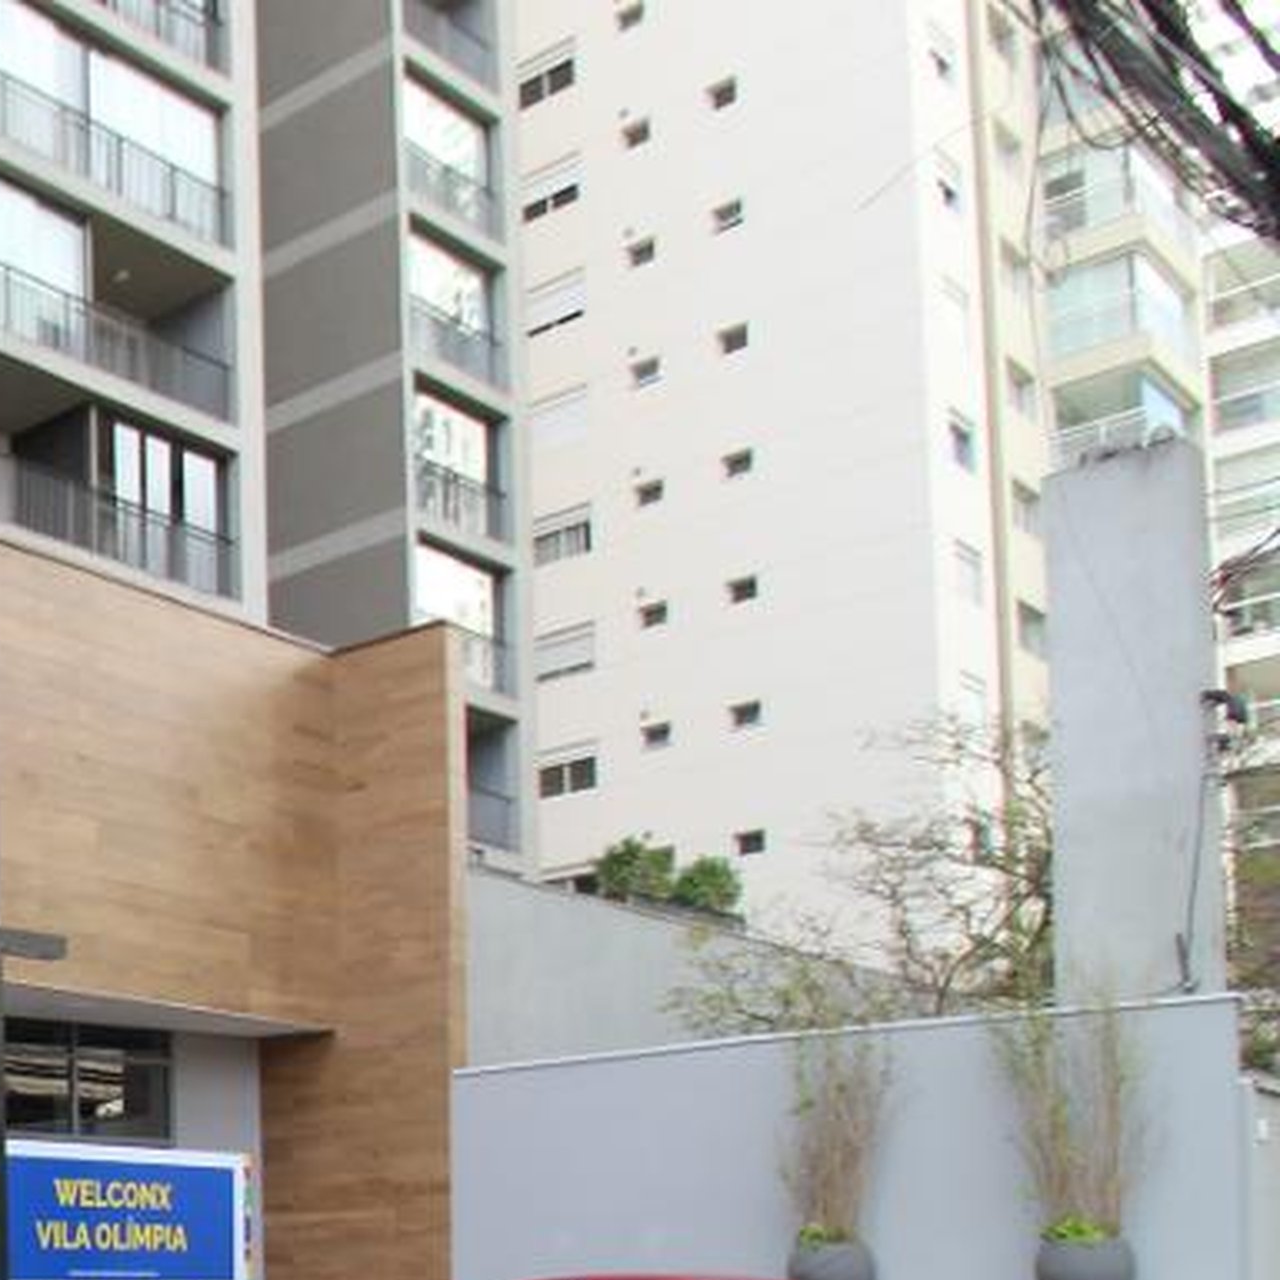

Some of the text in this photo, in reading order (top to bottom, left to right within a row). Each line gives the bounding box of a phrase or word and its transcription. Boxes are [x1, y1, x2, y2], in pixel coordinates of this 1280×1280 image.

[53, 1178, 173, 1211] WELCONX
[36, 1215, 189, 1252] VILA OLÍMPIA
